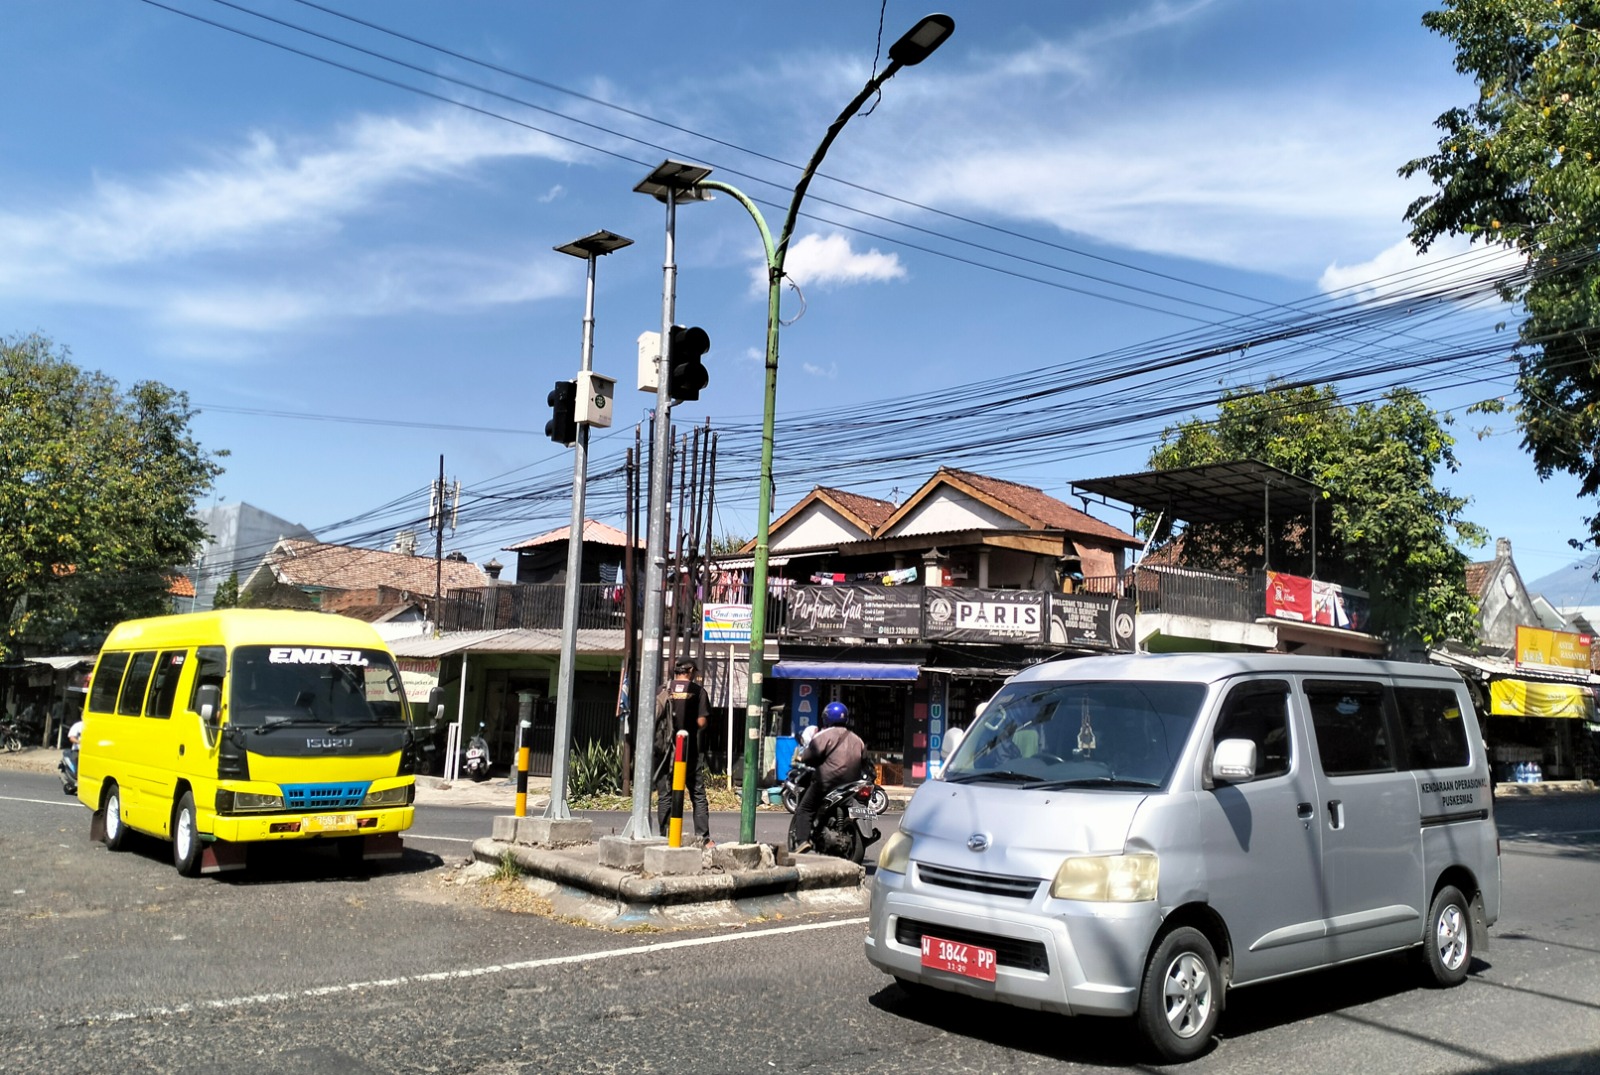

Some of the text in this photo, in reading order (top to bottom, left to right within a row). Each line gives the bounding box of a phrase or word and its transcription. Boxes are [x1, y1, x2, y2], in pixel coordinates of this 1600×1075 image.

[1052, 598, 1076, 606] WELCOME
[790, 589, 862, 630] Parfume Gua
[960, 602, 1037, 624] PARIS
[1078, 608, 1098, 616] SERVICE
[1080, 614, 1094, 622] PRICE
[1065, 620, 1098, 630] GOOD QUALITY
[306, 738, 353, 748] ISUZU
[1421, 780, 1454, 793] KENDARAAN
[1442, 794, 1473, 806] PUSKESMAS
[317, 816, 336, 826] 7597
[922, 938, 994, 970] W 1844 PP
